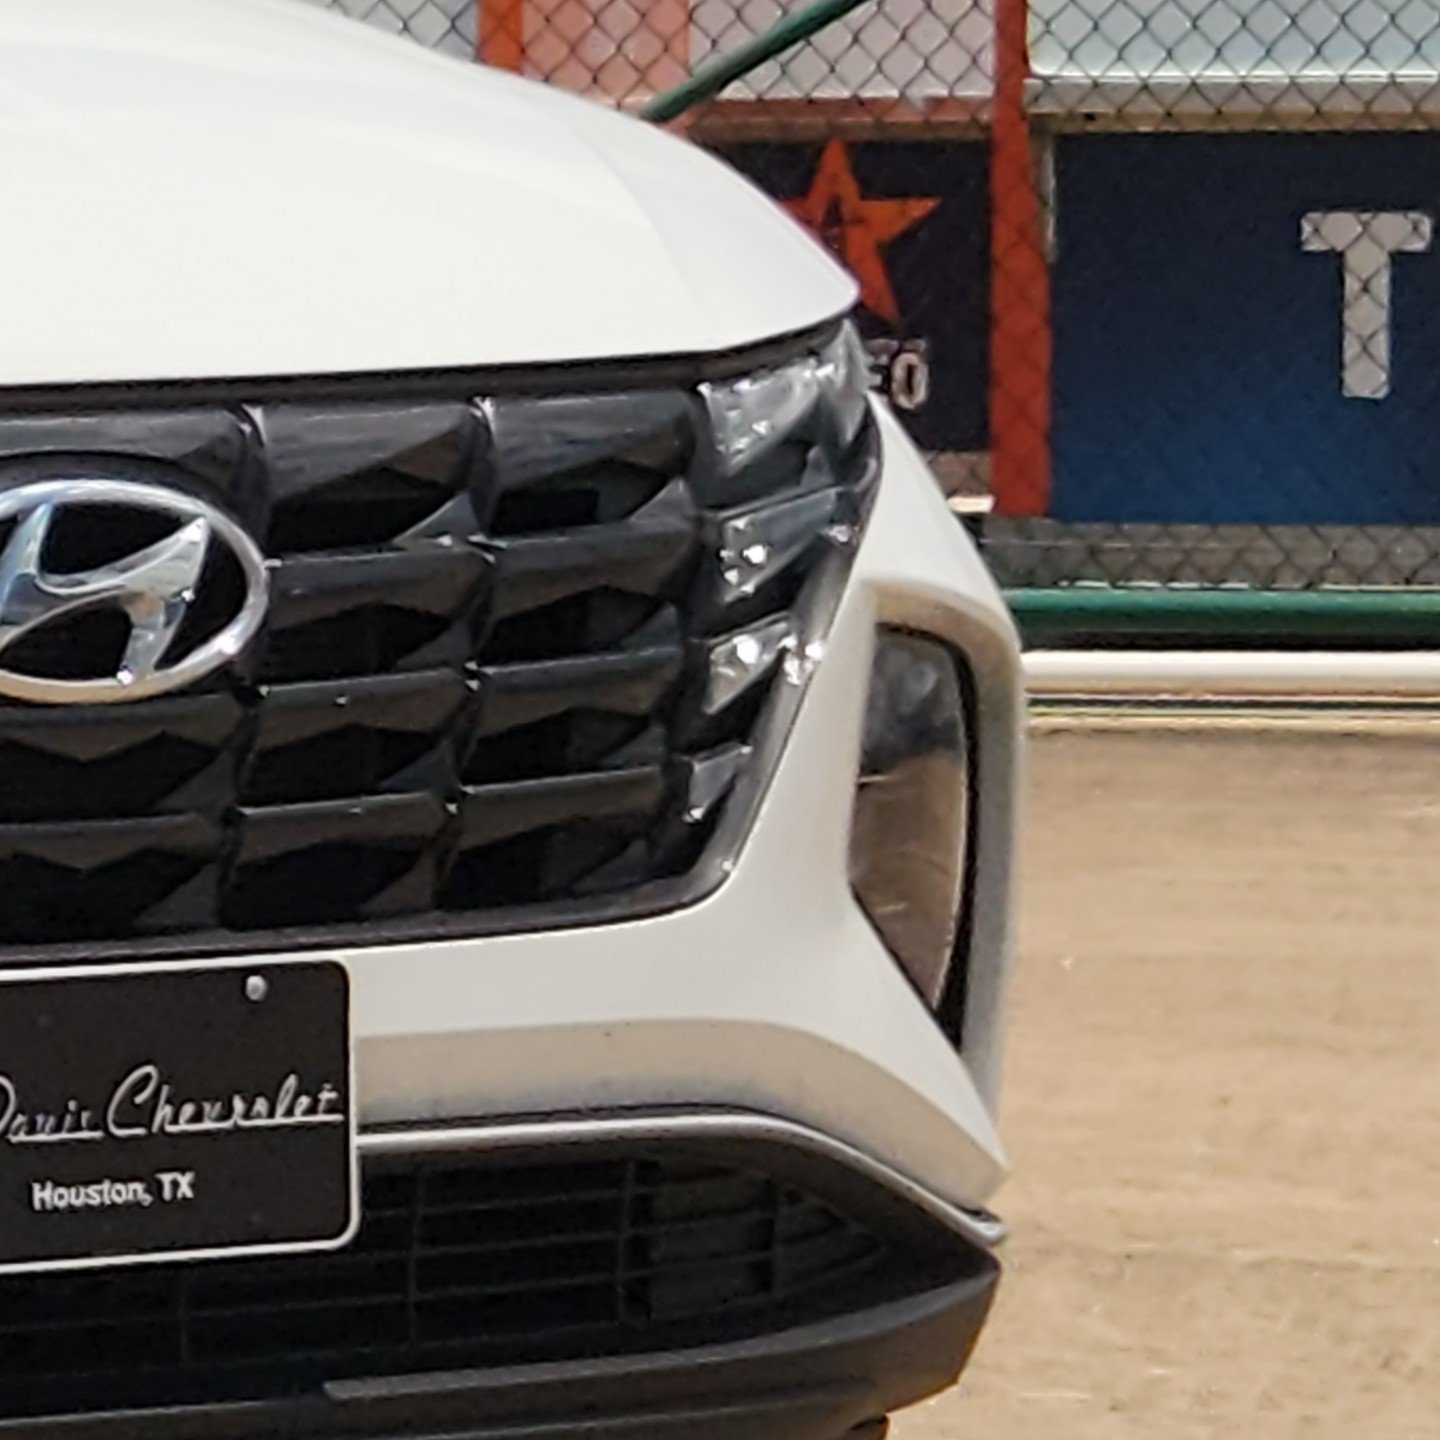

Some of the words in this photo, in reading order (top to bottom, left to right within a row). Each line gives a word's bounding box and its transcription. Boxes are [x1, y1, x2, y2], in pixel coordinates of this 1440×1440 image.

[106, 1064, 346, 1137] Chevrolet
[31, 1175, 153, 1212] Houston,
[154, 1171, 196, 1201] TX
